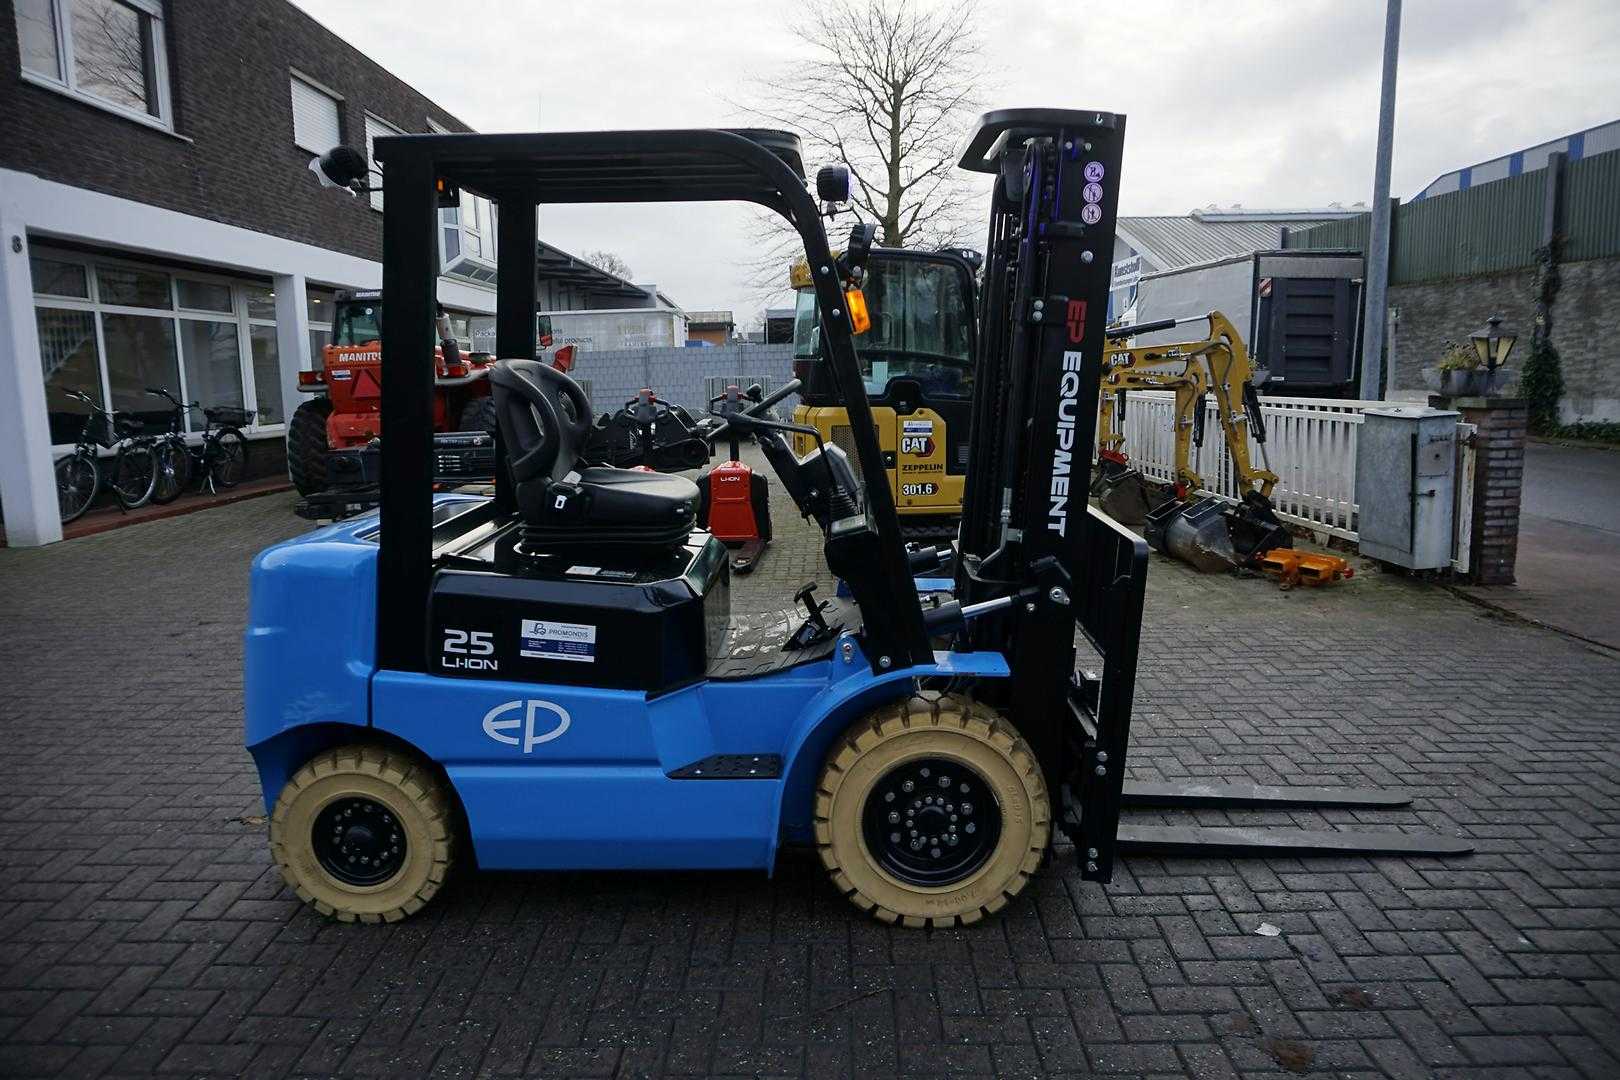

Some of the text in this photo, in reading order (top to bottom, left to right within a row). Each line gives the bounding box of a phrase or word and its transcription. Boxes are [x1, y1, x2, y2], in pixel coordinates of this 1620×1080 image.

[339, 351, 381, 362] MANITO
[1111, 352, 1130, 366] CAT
[1048, 300, 1087, 538] EP EQUIPMENT
[902, 437, 928, 454] CAT
[902, 463, 944, 472] ZEPPELIN
[902, 483, 933, 496] 301.6
[443, 628, 495, 656] 25
[482, 699, 571, 753] EP
